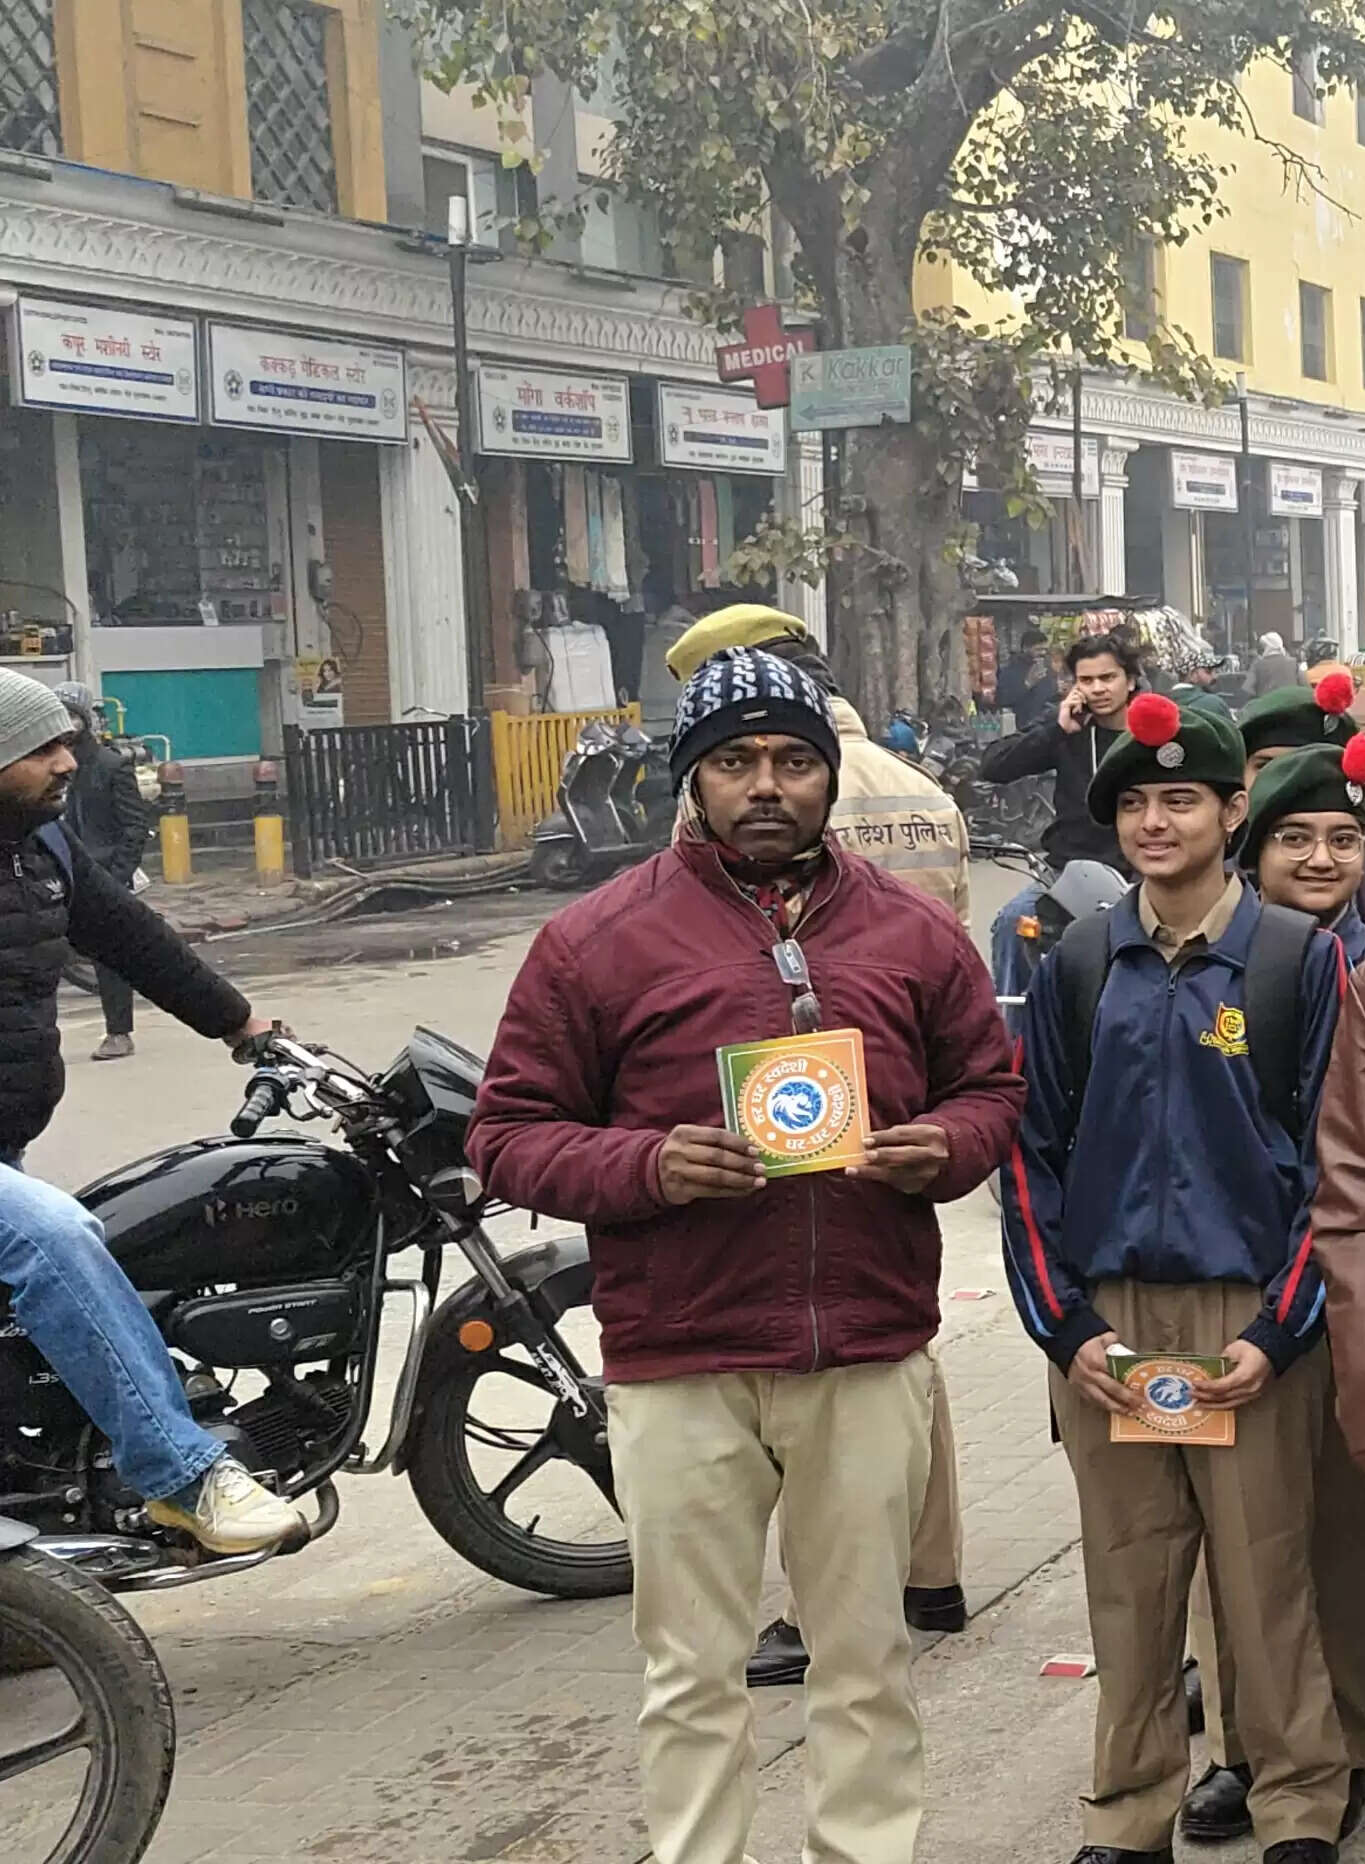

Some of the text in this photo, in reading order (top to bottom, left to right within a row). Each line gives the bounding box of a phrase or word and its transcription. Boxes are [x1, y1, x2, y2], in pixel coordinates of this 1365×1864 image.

[827, 356, 904, 381] Kakkar
[764, 1058, 808, 1083] स्वदेशी
[236, 1199, 298, 1218] Hero
